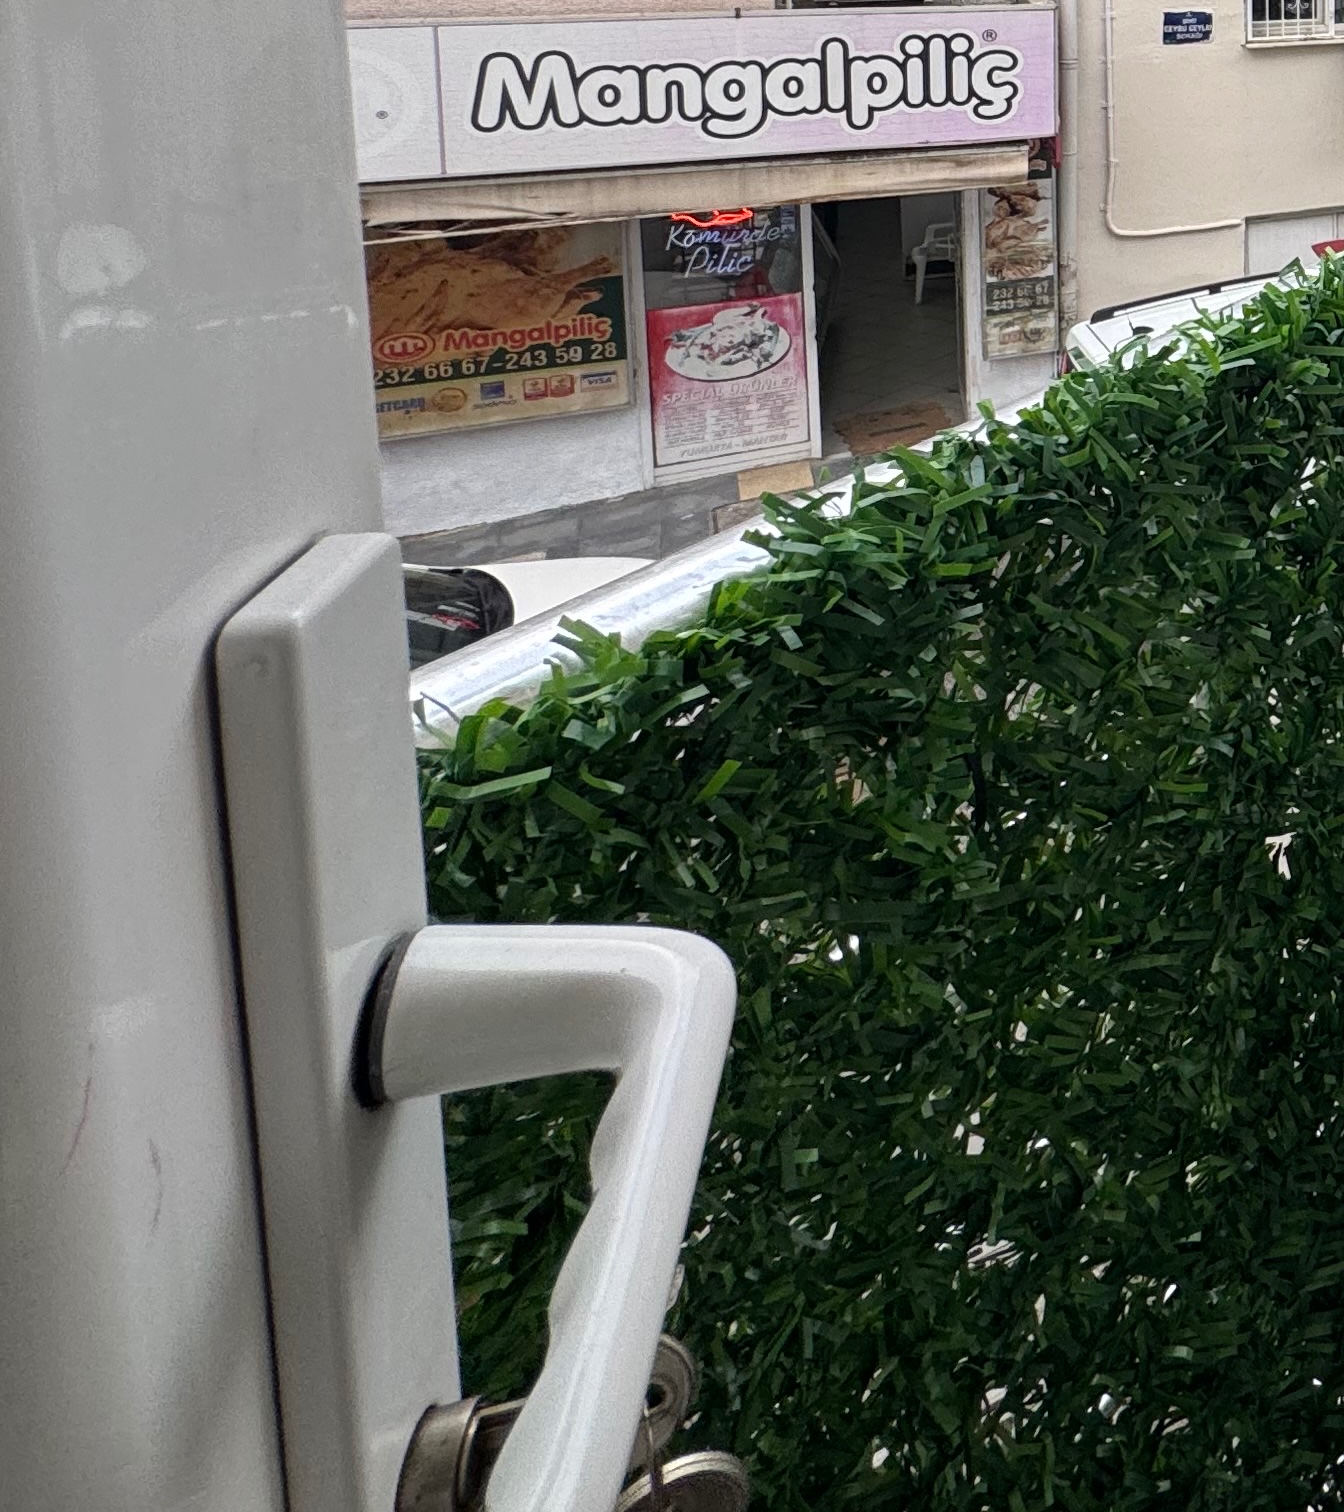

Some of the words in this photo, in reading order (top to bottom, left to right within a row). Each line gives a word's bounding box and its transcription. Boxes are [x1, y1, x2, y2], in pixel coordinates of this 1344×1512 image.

[471, 33, 1020, 140] Mangalpiliç
[442, 313, 612, 353] Mangalpiliç
[423, 360, 454, 380] 66
[589, 341, 618, 360] 28
